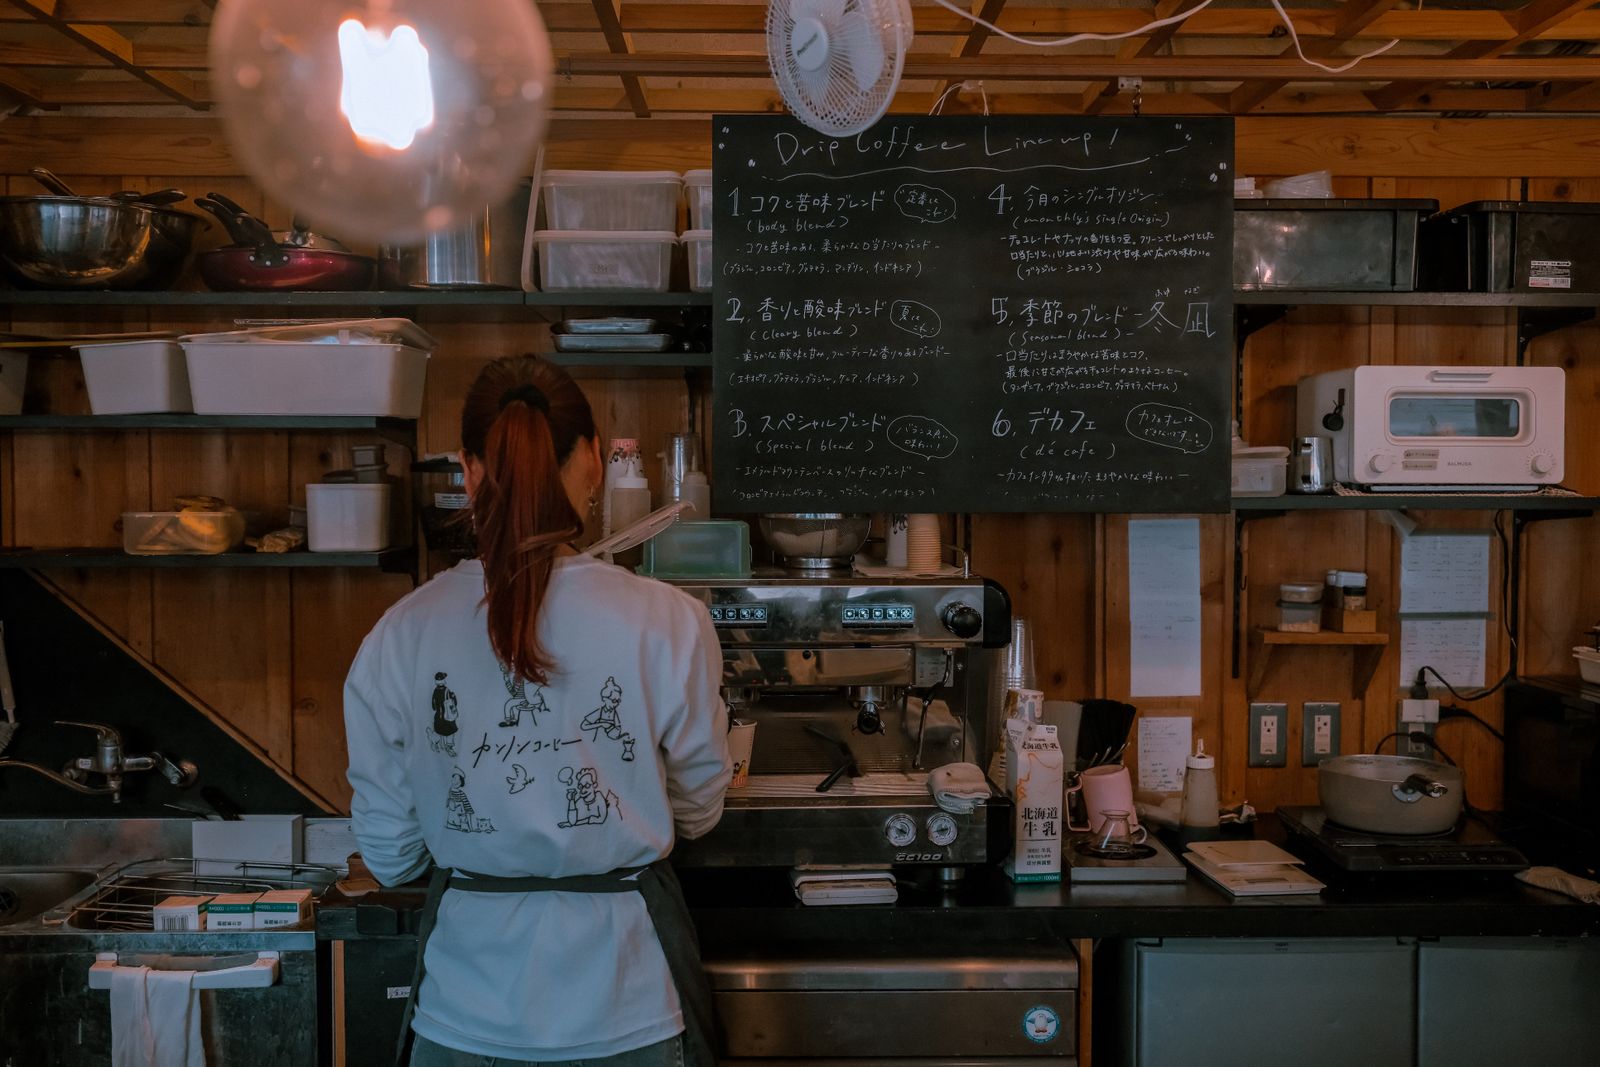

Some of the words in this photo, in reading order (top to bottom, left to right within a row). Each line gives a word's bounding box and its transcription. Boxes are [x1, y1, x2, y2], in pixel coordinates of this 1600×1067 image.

[774, 132, 839, 167] Drip
[856, 126, 968, 159] Coffee
[984, 125, 1054, 157] Line
[751, 191, 886, 214] コクと苦味ブレンド
[757, 297, 887, 321] 香りと酸味ブレンド
[760, 411, 887, 434] スペシャルブレンド
[1028, 408, 1097, 434] デカフェ
[1021, 806, 1059, 820] 北海道
[1023, 820, 1057, 837] 牛乳
